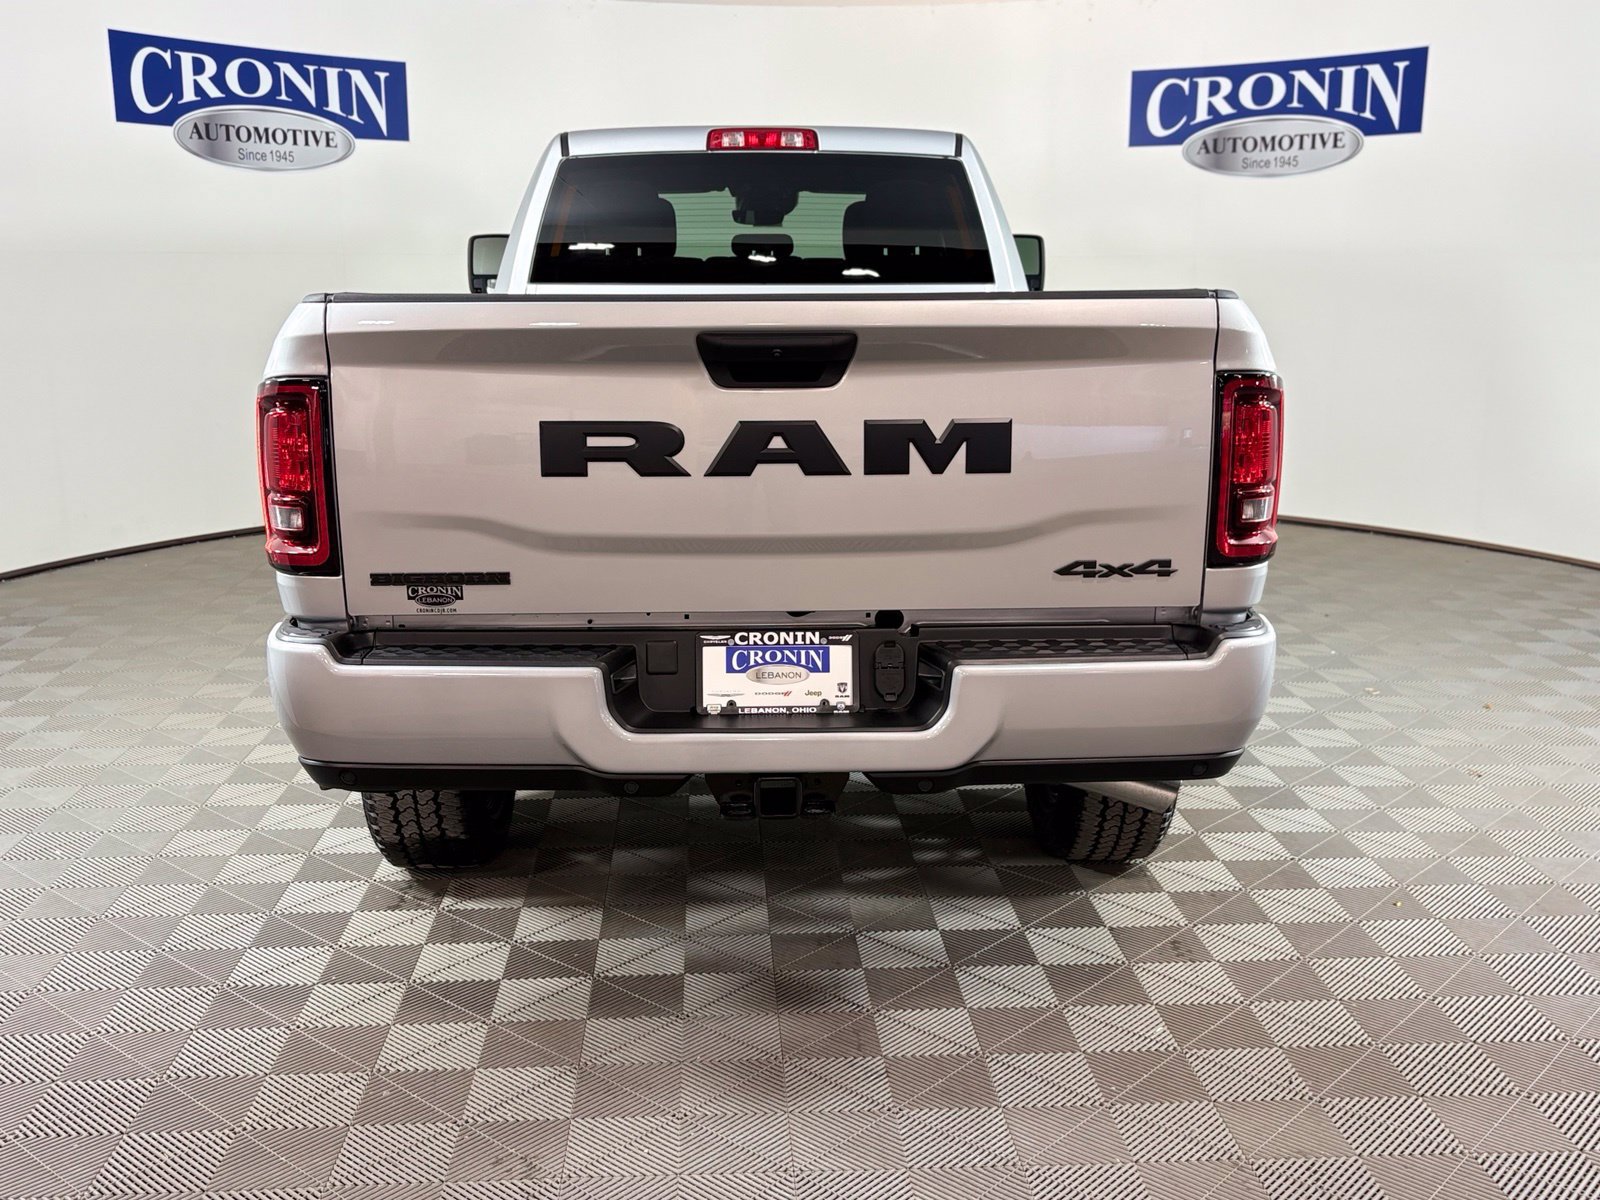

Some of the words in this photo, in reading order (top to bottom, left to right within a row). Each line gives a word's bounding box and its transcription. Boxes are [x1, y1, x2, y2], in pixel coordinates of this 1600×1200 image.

[130, 46, 390, 137] CRONIN
[1146, 61, 1410, 138] CRONIN
[189, 121, 338, 148] AUTOMOTIVE
[1197, 131, 1346, 155] AUTOMOTIVE
[237, 147, 267, 162] Since
[270, 149, 295, 163] 1945
[1241, 156, 1271, 169] Since
[1273, 155, 1299, 168] 1945
[539, 418, 1013, 476] RAM
[1053, 559, 1178, 578] 4x4
[408, 586, 462, 597] CRONIN
[734, 632, 820, 645] CRONIN
[732, 650, 823, 671] CRONIN
[755, 671, 802, 679] LEBANON
[804, 689, 823, 697] Jeep
